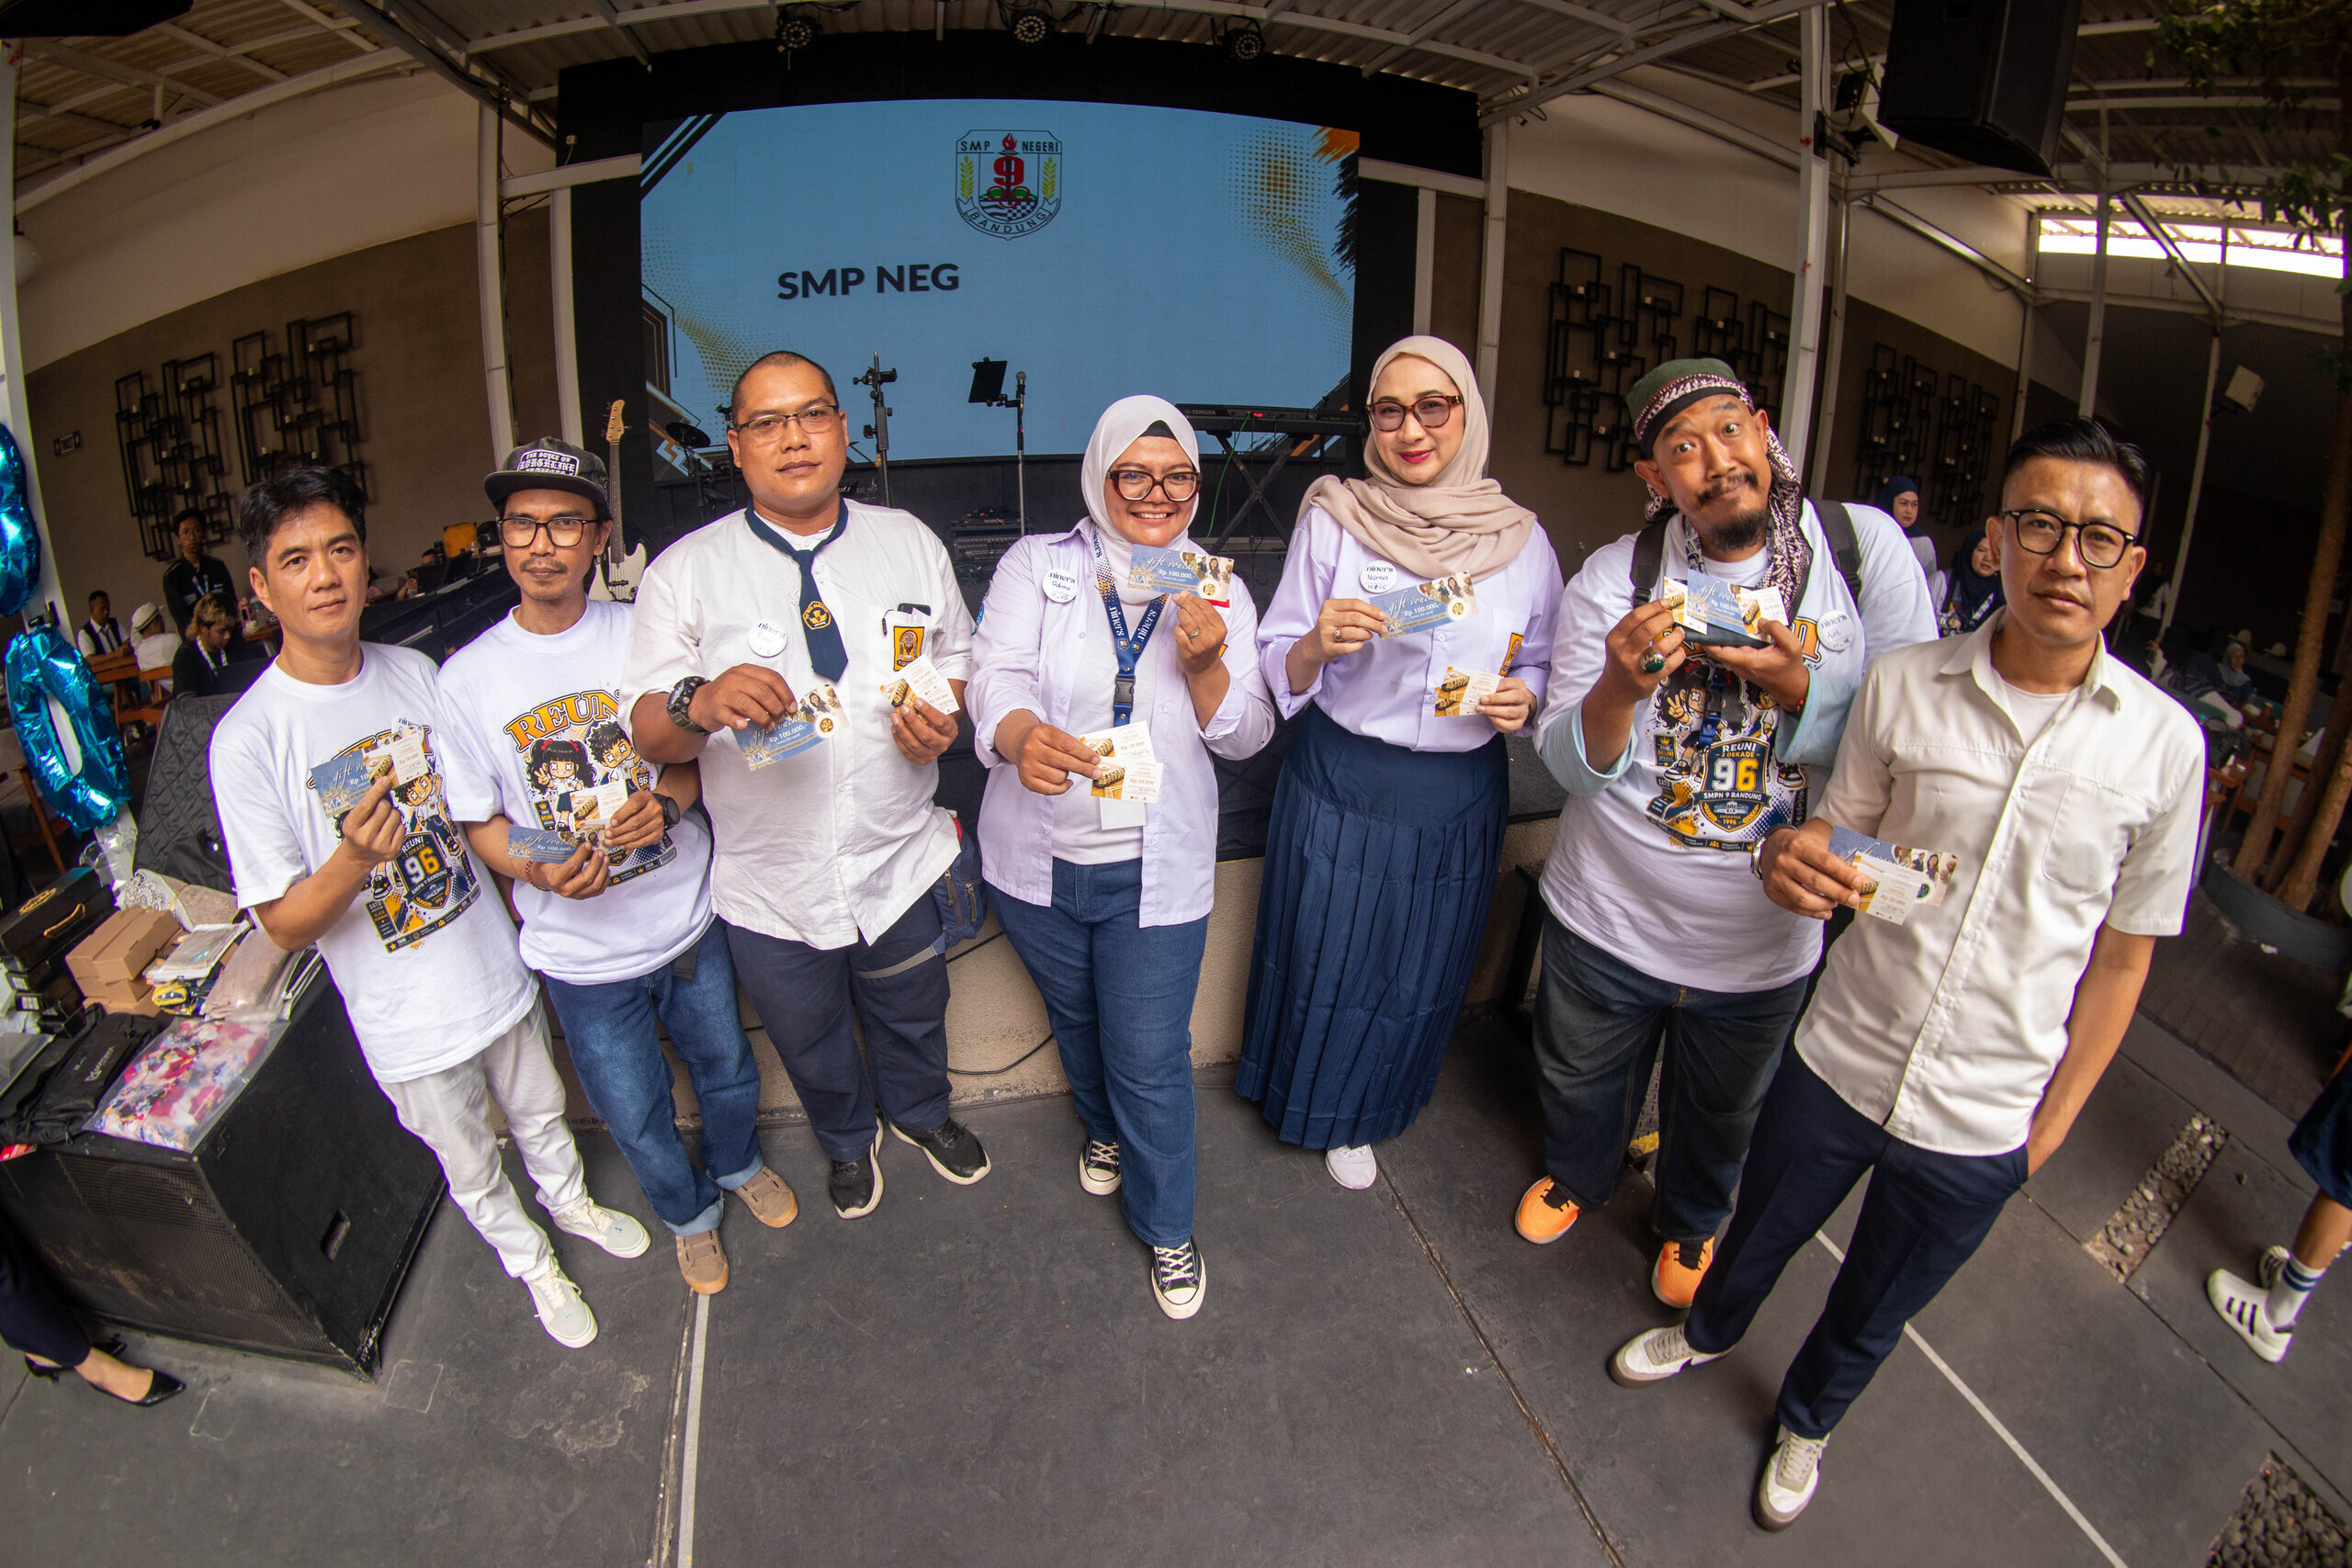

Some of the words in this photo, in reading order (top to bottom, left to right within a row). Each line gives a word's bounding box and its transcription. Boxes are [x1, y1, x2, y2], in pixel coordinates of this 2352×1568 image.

[960, 141, 990, 152] SMP
[1022, 141, 1058, 152] NEGERI
[993, 155, 1024, 186] 9
[969, 211, 1046, 233] BANDUNG
[777, 267, 865, 300] SMP
[876, 263, 959, 294] NEG
[1144, 550, 1171, 573] gift
[503, 690, 620, 753] REUN
[1722, 742, 1757, 752] REUNI
[349, 777, 359, 786] Rp
[638, 775, 649, 785] 96
[1711, 758, 1759, 791] 96
[1731, 792, 1762, 800] BANDUNG
[401, 836, 424, 853] REUNI
[404, 847, 440, 884] 96
[368, 900, 382, 910] SATU
